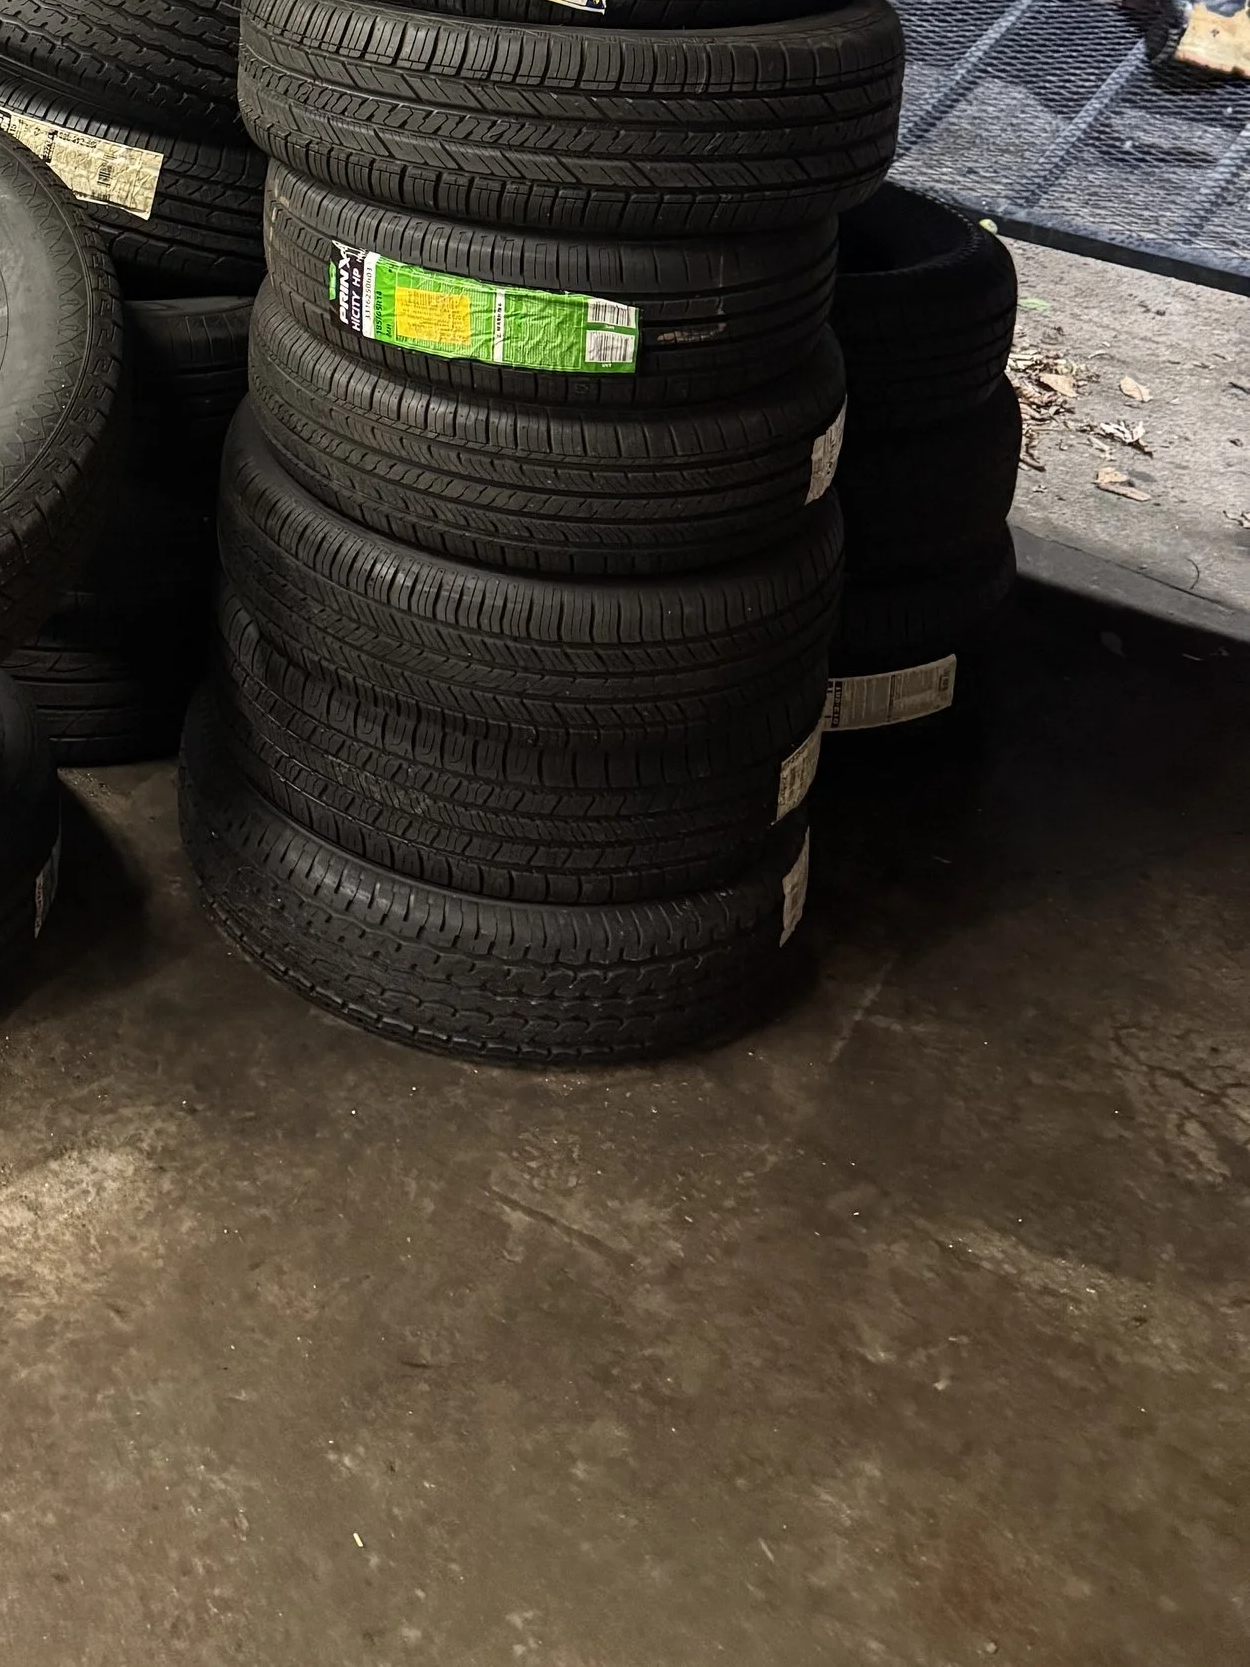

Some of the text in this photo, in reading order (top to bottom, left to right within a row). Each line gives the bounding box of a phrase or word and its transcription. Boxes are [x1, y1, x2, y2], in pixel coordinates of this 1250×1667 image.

[338, 254, 351, 325] PRINX
[350, 267, 361, 332] HICITY HP
